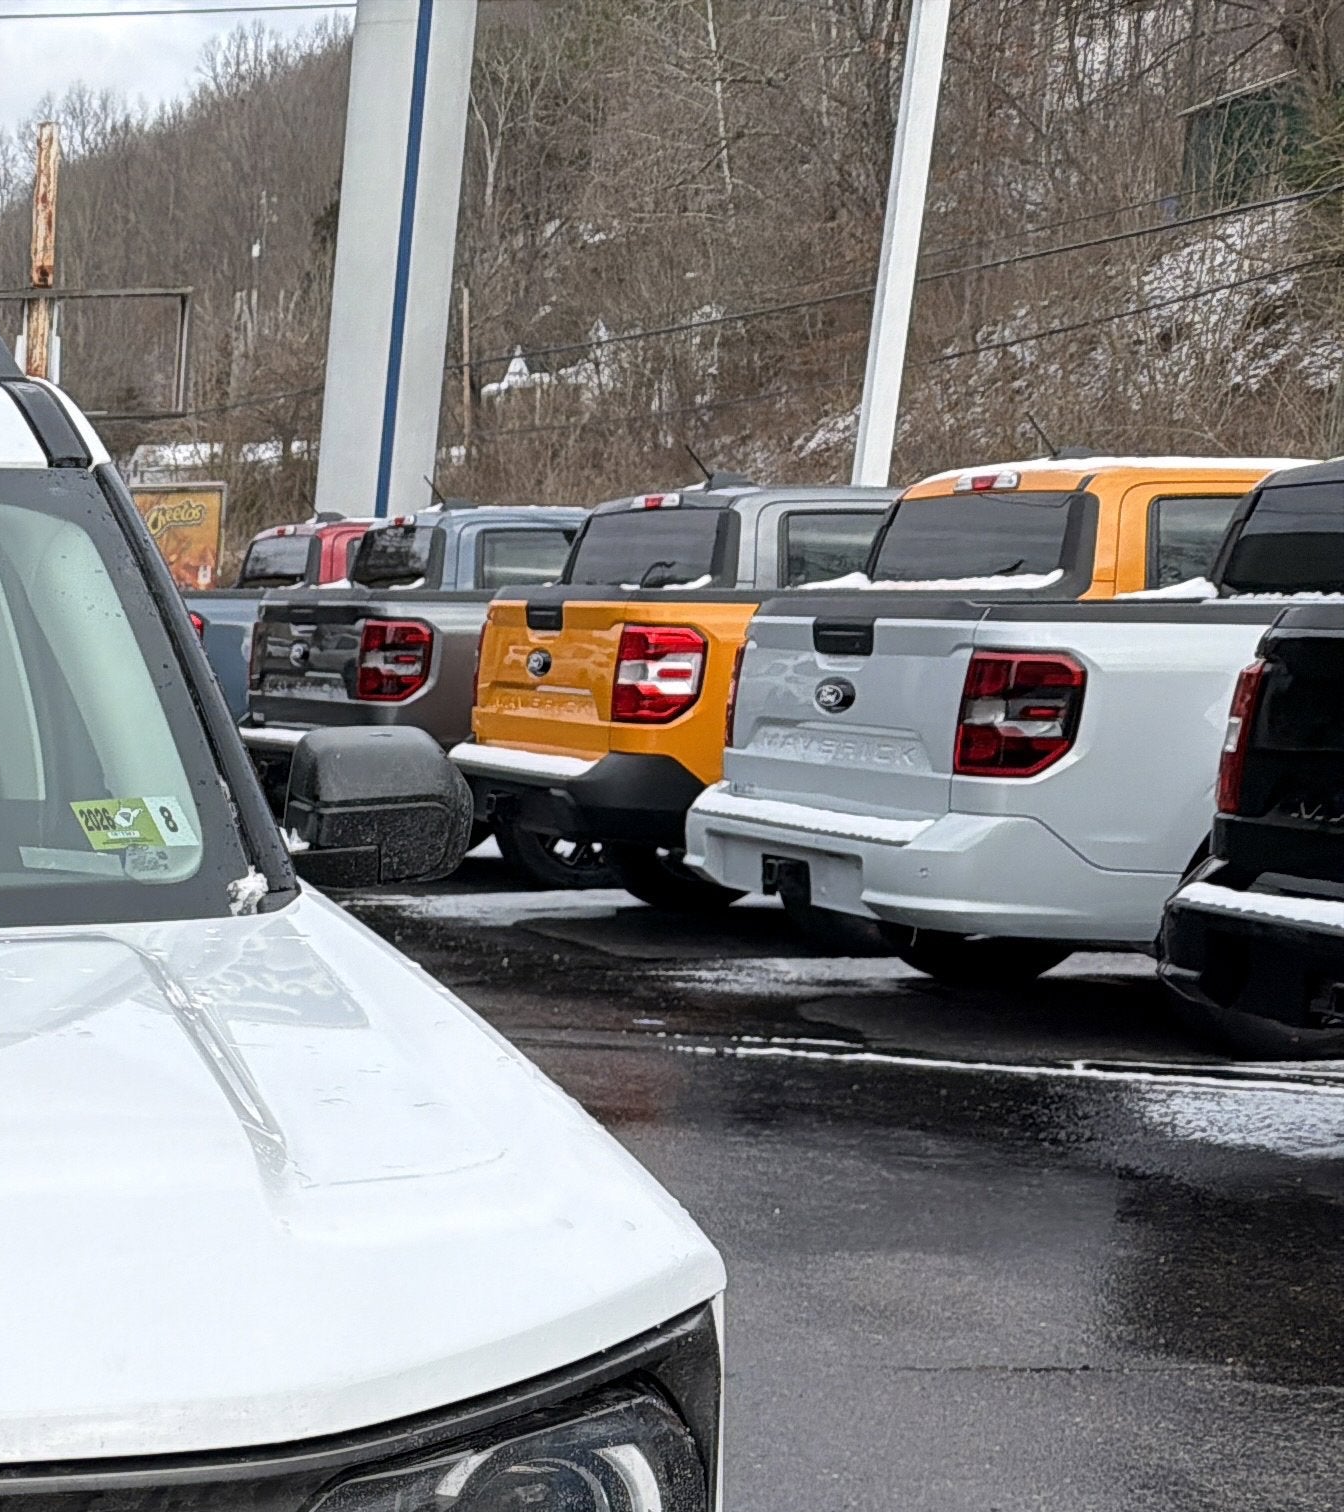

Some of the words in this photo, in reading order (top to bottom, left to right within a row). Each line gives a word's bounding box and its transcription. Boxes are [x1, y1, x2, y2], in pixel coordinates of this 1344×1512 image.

[146, 500, 203, 535] Cheetos
[79, 807, 116, 832] 2026
[159, 806, 179, 832] 8
